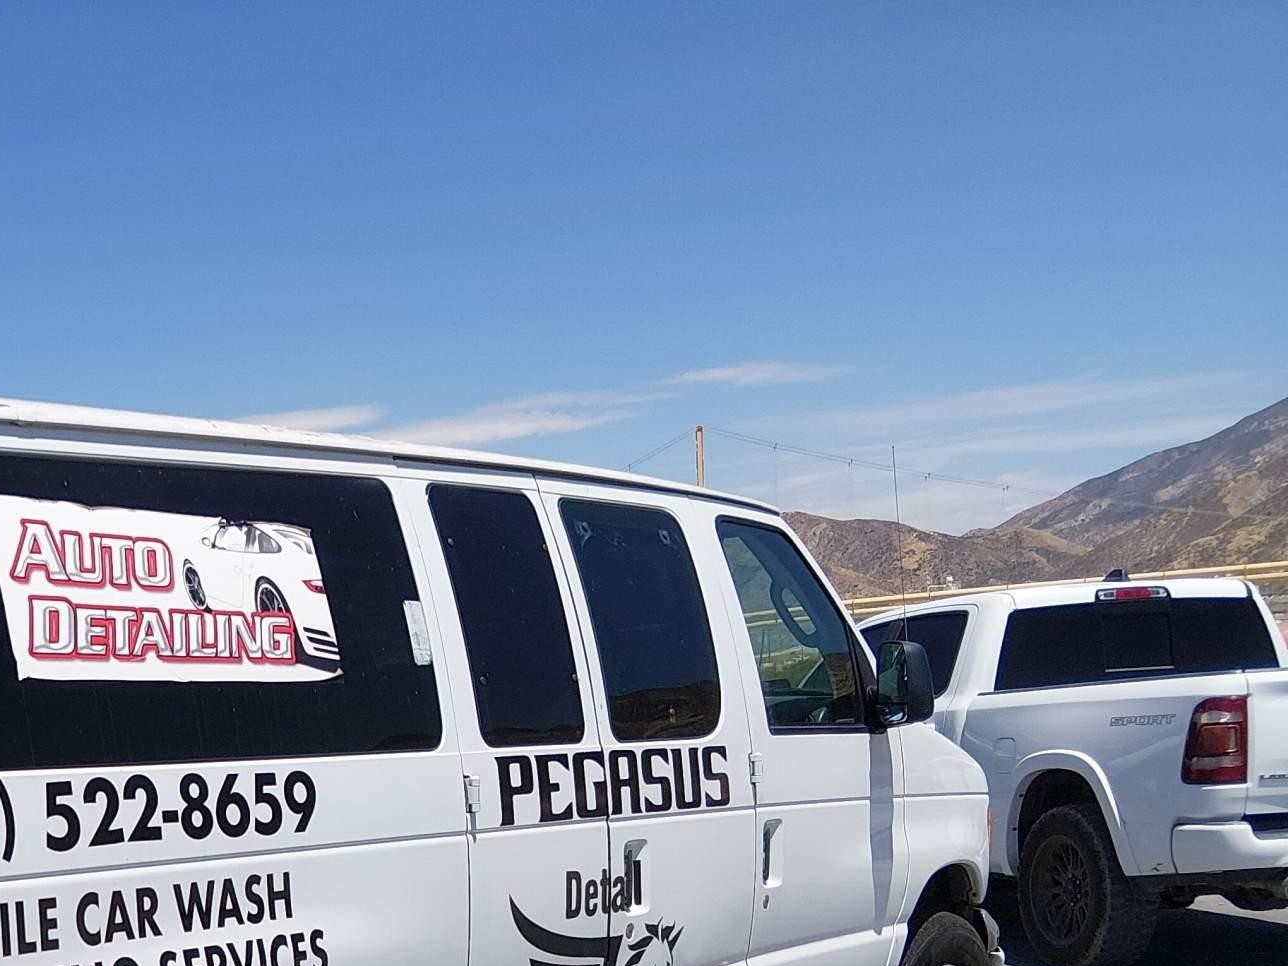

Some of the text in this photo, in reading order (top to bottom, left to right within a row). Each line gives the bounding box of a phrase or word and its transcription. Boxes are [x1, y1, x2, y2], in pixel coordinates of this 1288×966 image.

[10, 518, 174, 590] AUTO
[28, 595, 296, 664] DETAILING
[1109, 714, 1176, 727] SPORT
[45, 770, 317, 852] 522-8659
[494, 745, 731, 826] PEGASUS
[75, 886, 162, 947] CAR
[172, 871, 294, 933] WASH
[565, 859, 643, 919] Detal
